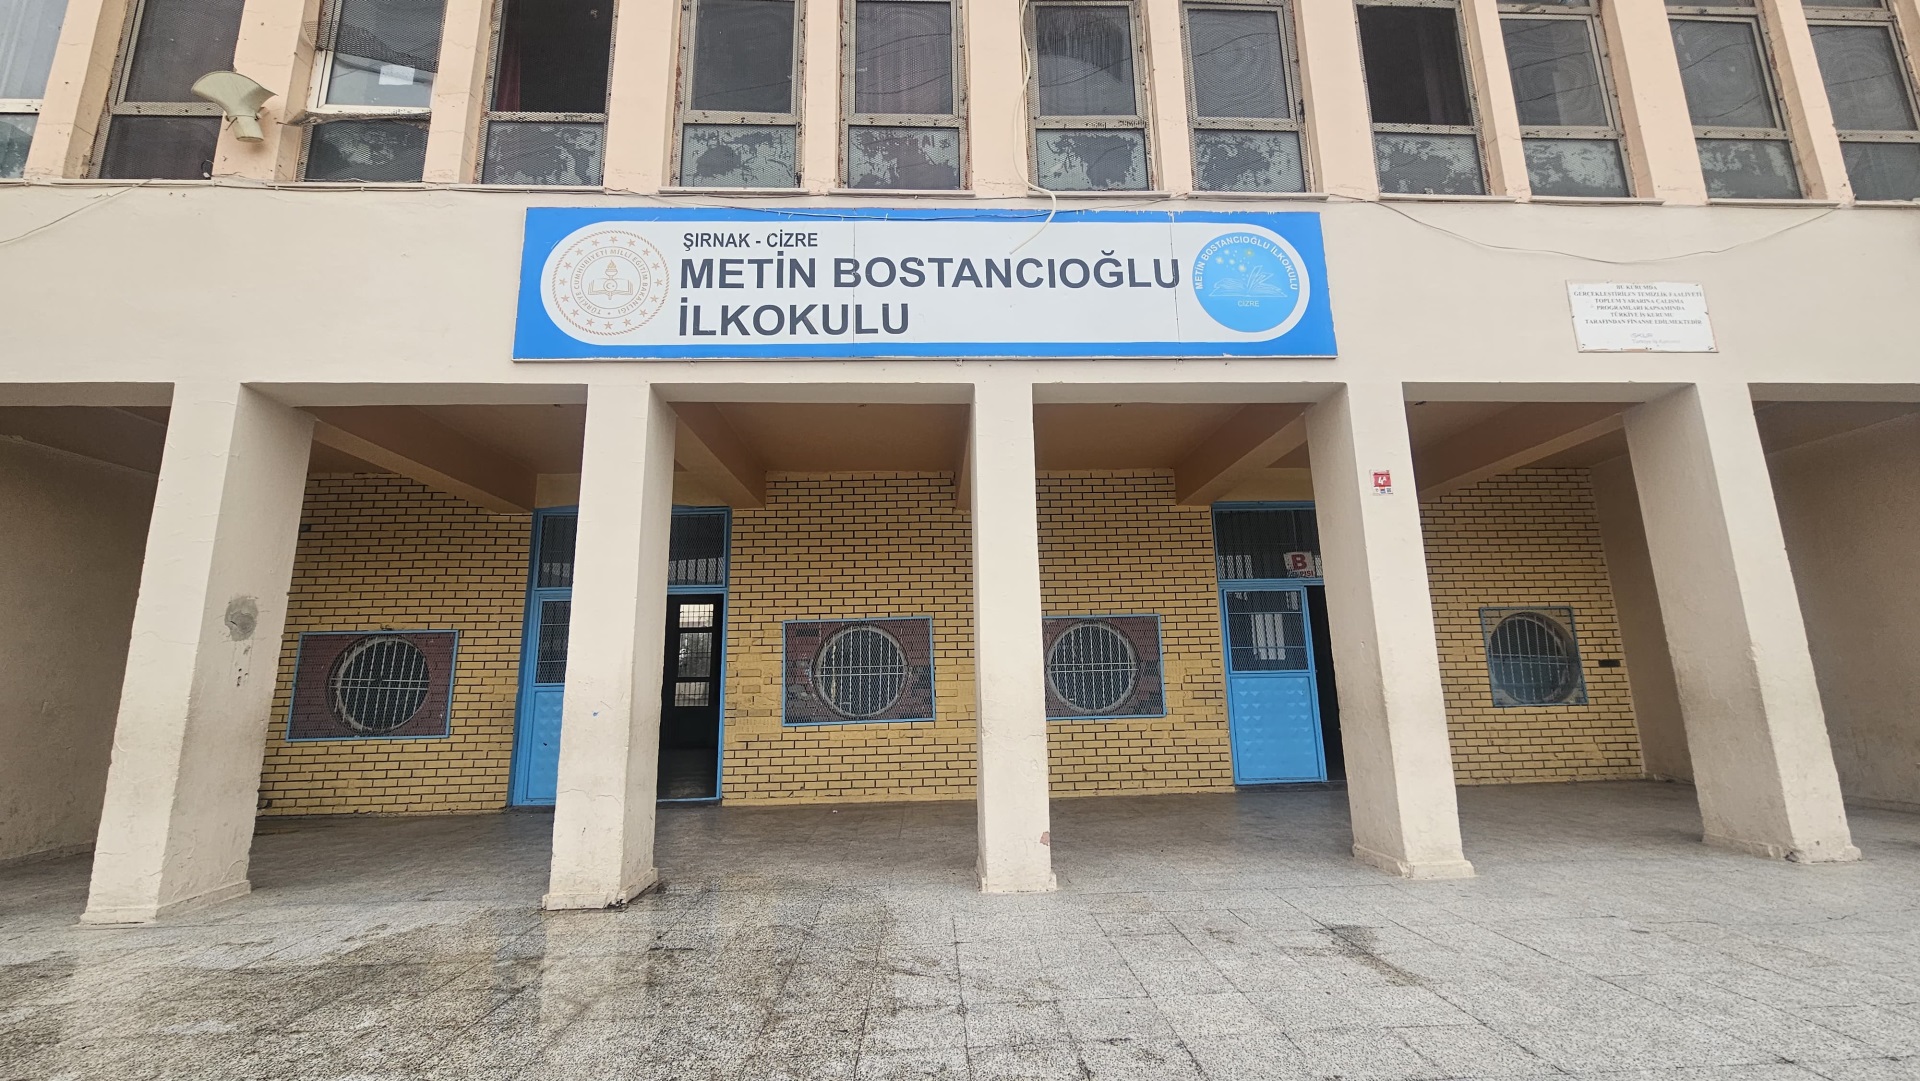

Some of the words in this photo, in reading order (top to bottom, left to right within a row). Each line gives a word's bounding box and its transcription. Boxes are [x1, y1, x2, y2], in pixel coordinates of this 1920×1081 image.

[610, 248, 631, 259] MİLLİ
[683, 232, 751, 251] ŞIRNAK
[766, 229, 818, 247] CİZRE
[573, 249, 608, 290] CUMHURİYETİ
[680, 250, 816, 289] METİN
[834, 250, 1180, 288] BOSTANCIOĞLU
[1195, 261, 1206, 290] METİN
[1201, 236, 1270, 261] BOSTANCIOĞLU
[1270, 245, 1298, 290] İLKOKULU
[575, 292, 601, 315] TÜRKİYE
[617, 282, 648, 315] BAKANLIĞI
[679, 297, 909, 336] İLKOKULU
[1291, 554, 1307, 570] B
